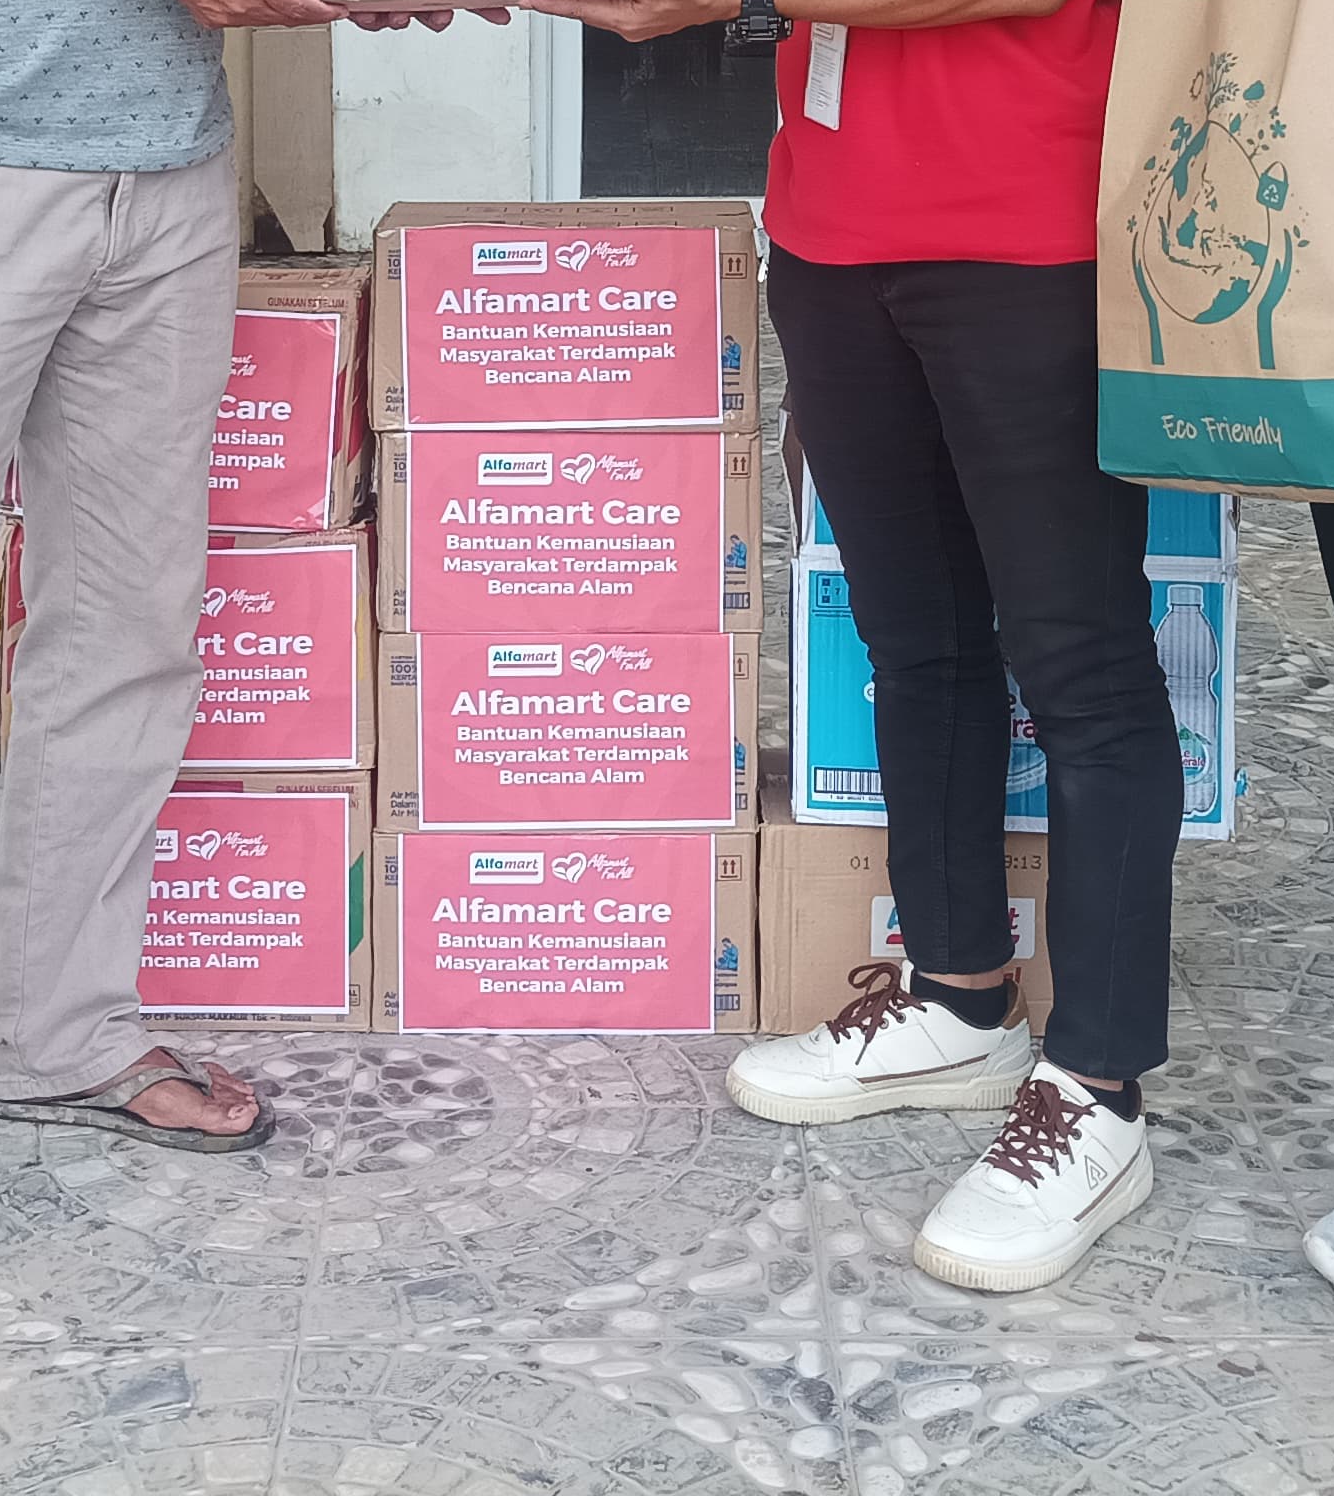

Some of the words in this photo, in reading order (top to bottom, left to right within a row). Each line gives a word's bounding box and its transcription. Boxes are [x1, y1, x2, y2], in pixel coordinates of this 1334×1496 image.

[478, 248, 542, 259] Alfamart
[435, 288, 590, 314] Alfamart
[598, 286, 677, 311] Care
[442, 324, 528, 340] Bantuan
[533, 320, 672, 339] Kemanusiaan
[440, 345, 555, 366] Masyarakat
[559, 342, 675, 362] Terdampak
[485, 369, 572, 384] Bencana
[576, 367, 631, 383] Alam
[217, 395, 291, 420] Care
[213, 429, 283, 446] usiaan
[1161, 415, 1198, 439] Eco
[1201, 416, 1283, 453] Friendly
[209, 451, 285, 471] ampak
[483, 459, 547, 471] Alfamart
[208, 476, 239, 489] am
[440, 498, 594, 524] Alfamart
[602, 500, 681, 524] Care
[446, 535, 531, 550] Bantuan
[537, 534, 675, 550] Kemanusiaan
[443, 557, 558, 575] Masyarakat
[562, 557, 677, 574] Terdampak
[488, 580, 574, 595] Bencana
[579, 579, 633, 595] Alam
[234, 632, 313, 655] Care
[493, 651, 556, 662] Alfamart
[203, 665, 307, 680] anusiaan
[451, 689, 604, 716] Alfamart
[613, 689, 691, 714] Care
[211, 709, 265, 723] Alam
[457, 726, 543, 741] Bantuan
[548, 723, 686, 740] Kemanusiaan
[454, 747, 570, 766] Masyarakat
[574, 745, 689, 763] Terdampak
[499, 769, 585, 785] Bencana
[591, 768, 645, 783] Alam
[475, 858, 539, 869] Alfamart
[850, 856, 870, 869] 01
[228, 875, 306, 900] Care
[163, 909, 300, 925] Kemanusiaan
[432, 897, 585, 923] Alfamart
[594, 899, 672, 923] Care
[189, 931, 304, 949] Terdampak
[438, 933, 523, 949] Bantuan
[528, 933, 666, 949] Kemanusiaan
[141, 955, 201, 968] ncana
[205, 953, 259, 968] Alam
[435, 955, 550, 973] Masyarakat
[554, 954, 669, 973] Terdampak
[479, 978, 565, 993] Bencana
[570, 977, 624, 993] Alam
